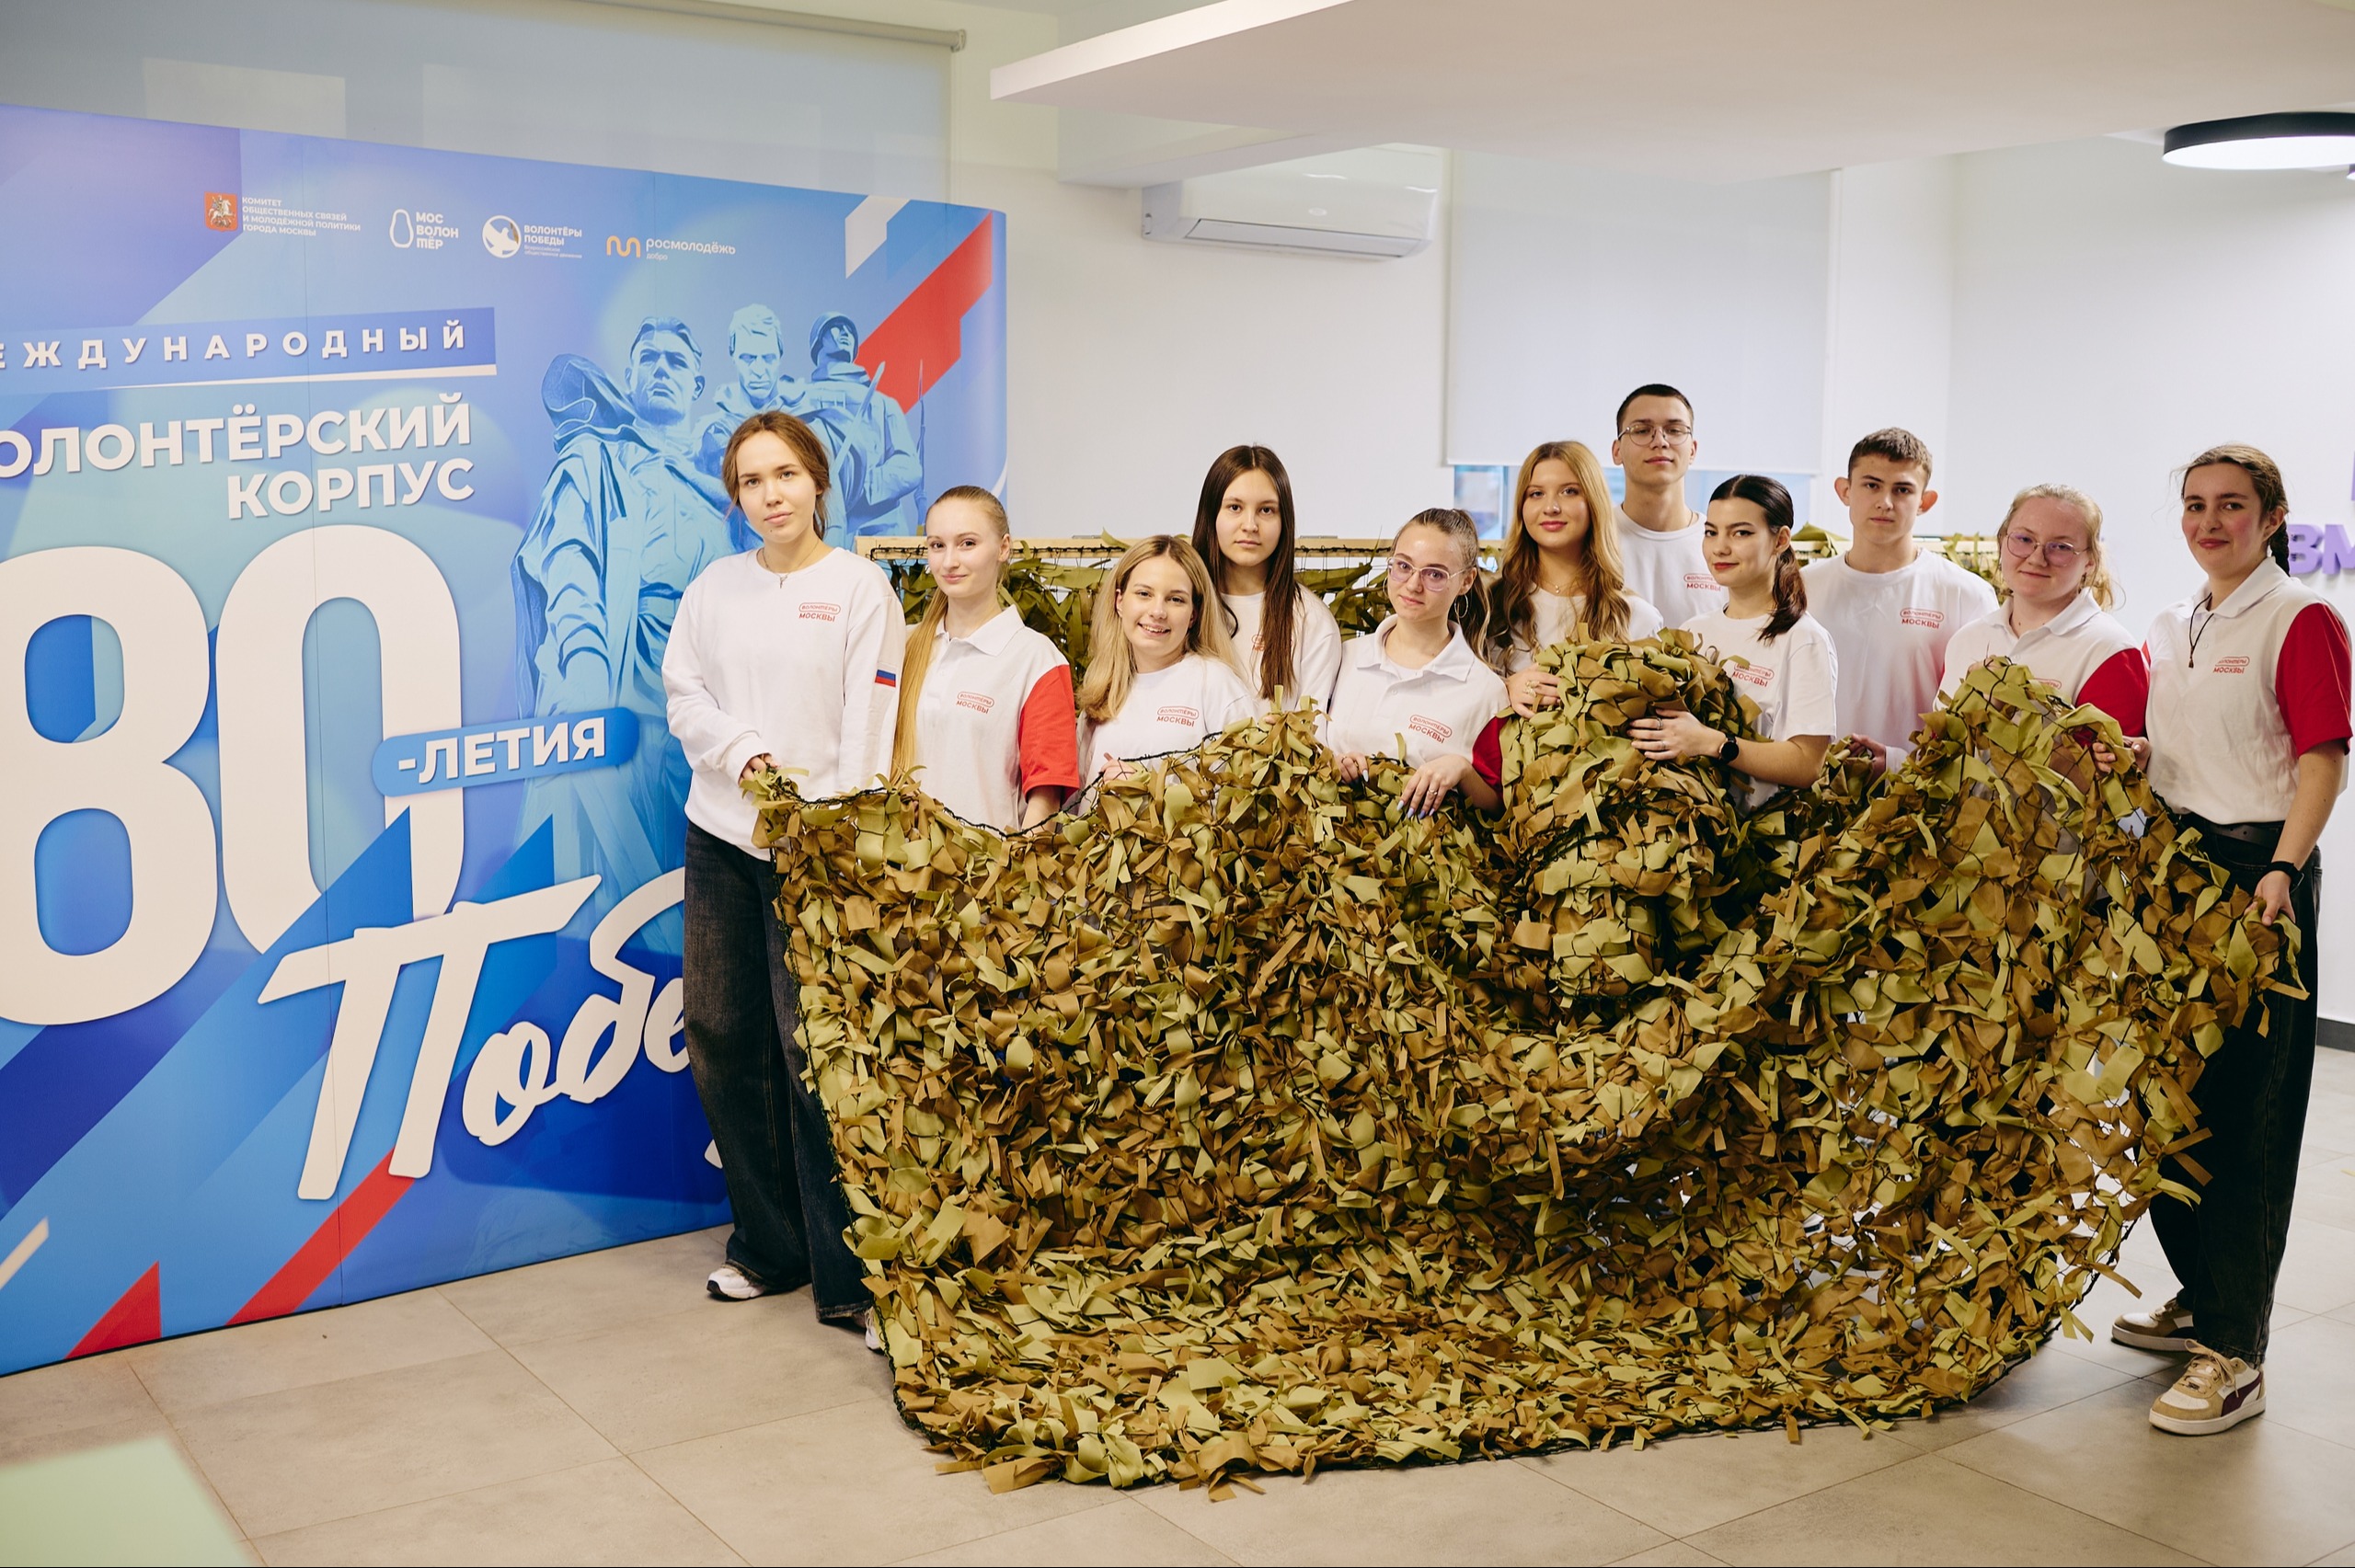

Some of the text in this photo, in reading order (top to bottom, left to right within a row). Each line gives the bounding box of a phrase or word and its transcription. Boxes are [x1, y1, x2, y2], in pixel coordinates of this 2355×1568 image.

[242, 197, 281, 207] КОМИТЕТ
[242, 206, 347, 222] ОБЩЕСТВЕННЫХ СВЯЗЕЙ
[416, 212, 443, 223] МОС
[251, 215, 314, 227] МОЛОДЁЖНОЙ
[316, 221, 361, 231] ПОЛИТИКИ
[243, 225, 316, 236] ГОРОДА МОСКВЫ
[416, 224, 459, 238] ВОЛОН
[523, 224, 582, 237] ВОЛОНТЁРЫ
[523, 235, 565, 246] ПОБЕДЫ
[0, 319, 465, 370] ЖДУНАРОДНЫЙ
[227, 458, 475, 520] КОРПУС
[1686, 583, 1721, 591] МОСКВЫ
[798, 612, 835, 622] МОСКВЫ
[1901, 618, 1940, 629] МОСКВЫ
[1731, 670, 1768, 687] МОСКВЫ
[956, 700, 989, 714] МОСКВЫ
[1156, 715, 1195, 727] МОСКВЫ
[1408, 723, 1445, 744] МОСКВЫ
[0, 524, 465, 1026] 80
